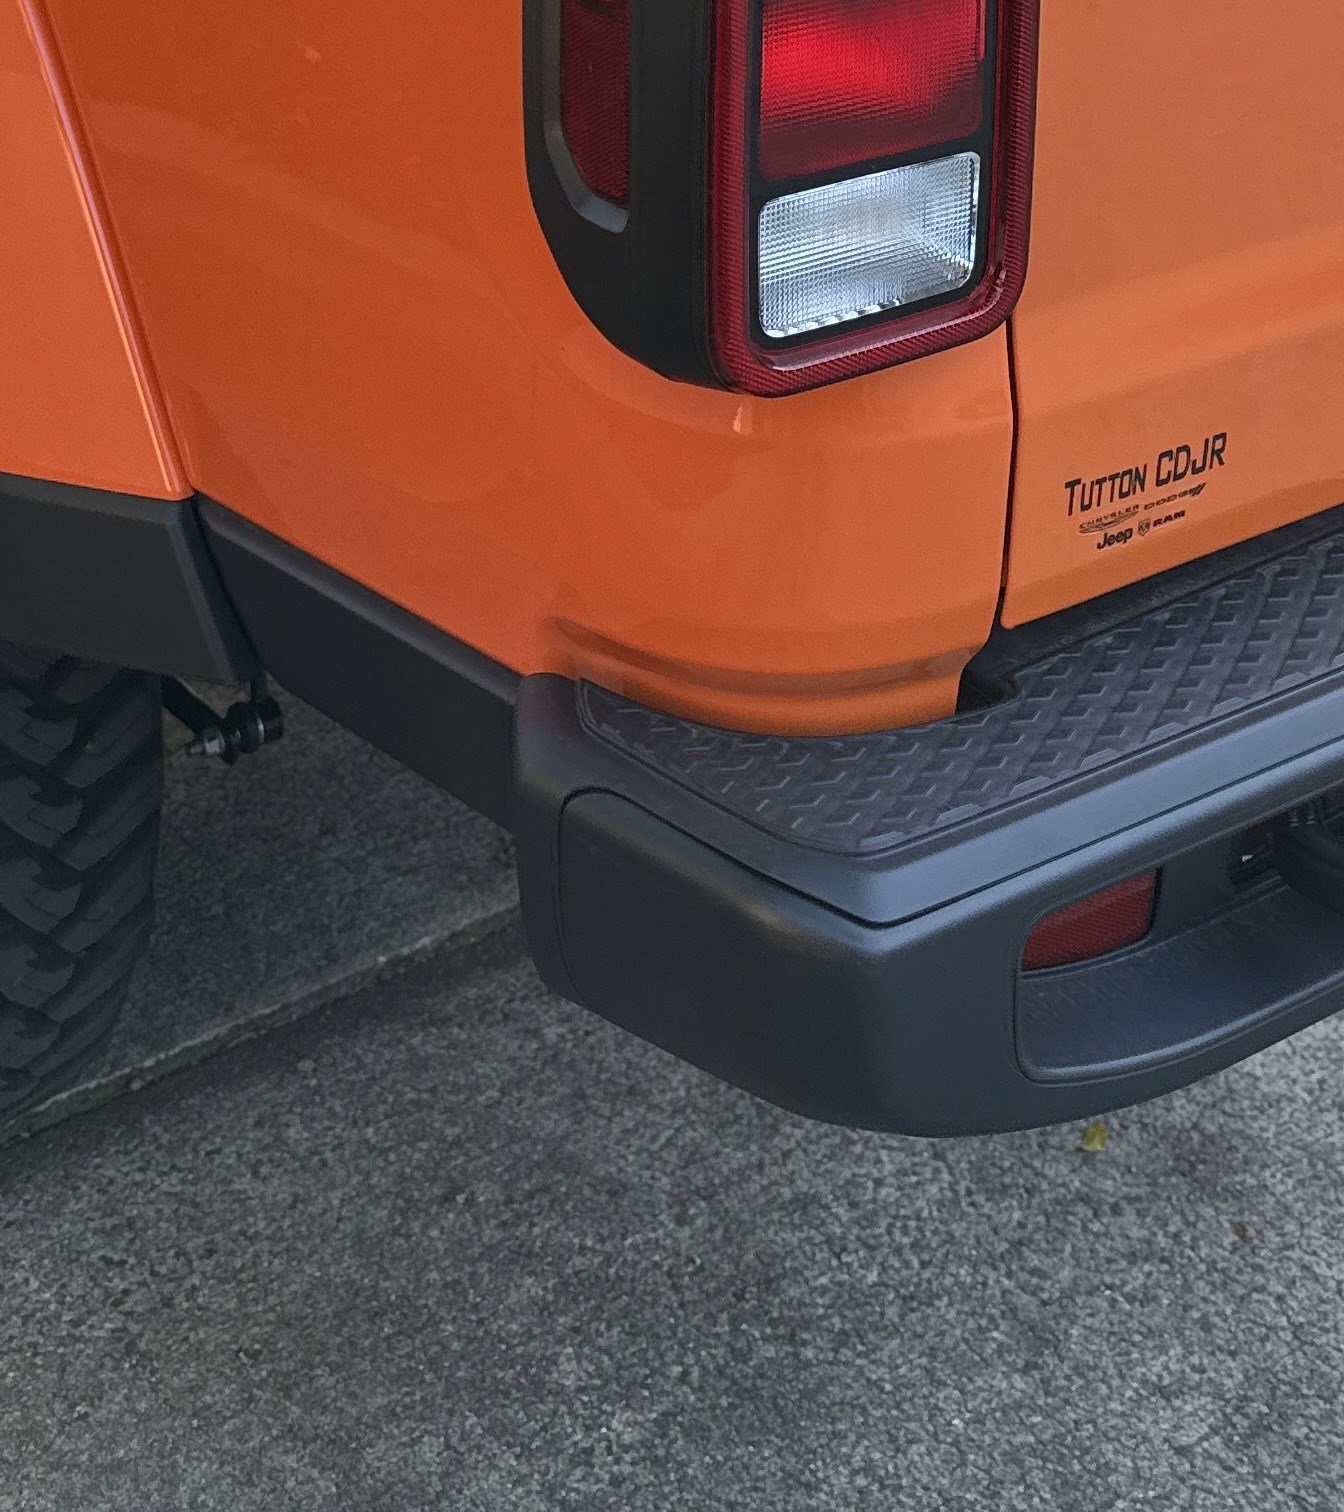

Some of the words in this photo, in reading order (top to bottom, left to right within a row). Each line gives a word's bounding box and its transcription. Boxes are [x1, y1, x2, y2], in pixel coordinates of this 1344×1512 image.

[1064, 463, 1149, 517] TUTTON
[1155, 432, 1228, 488] CDJR
[1096, 526, 1133, 550] Jeep
[1152, 509, 1186, 528] RAM
